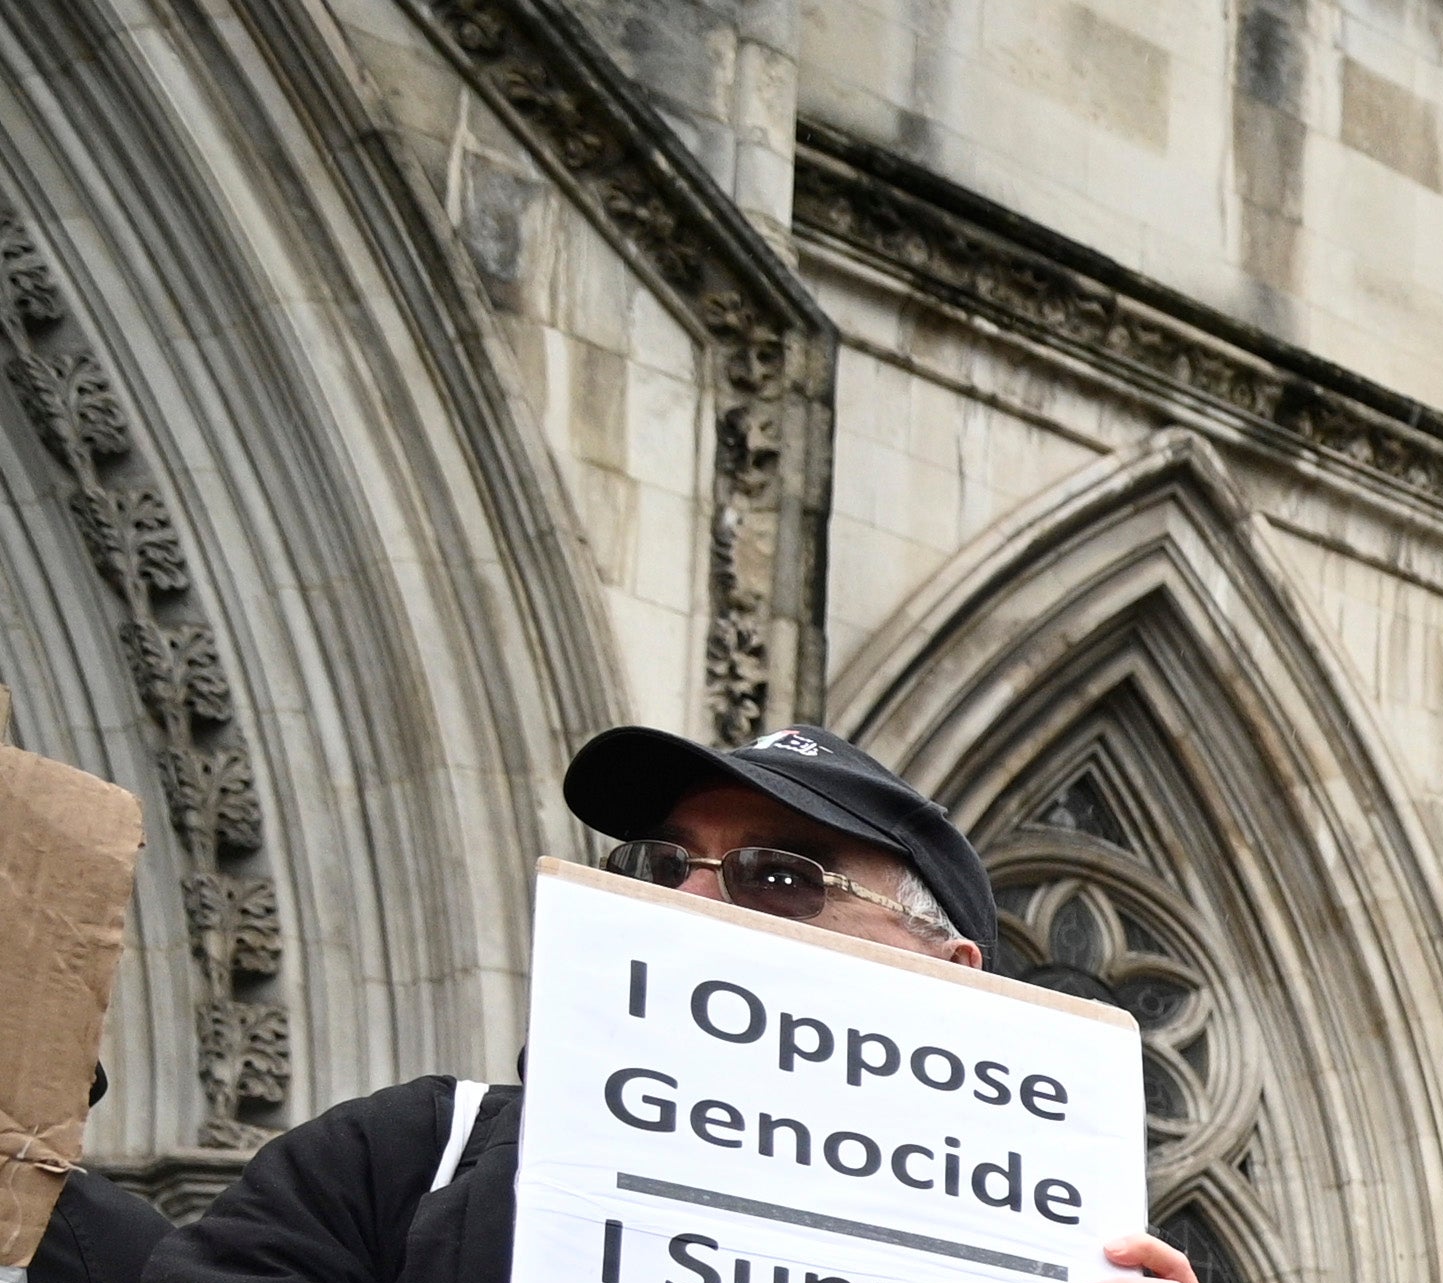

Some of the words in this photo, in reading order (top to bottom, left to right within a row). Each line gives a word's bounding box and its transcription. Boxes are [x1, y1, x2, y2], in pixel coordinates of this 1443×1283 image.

[628, 960, 648, 1018] I
[690, 980, 1069, 1122] Oppose
[603, 1068, 1082, 1225] Genocide
